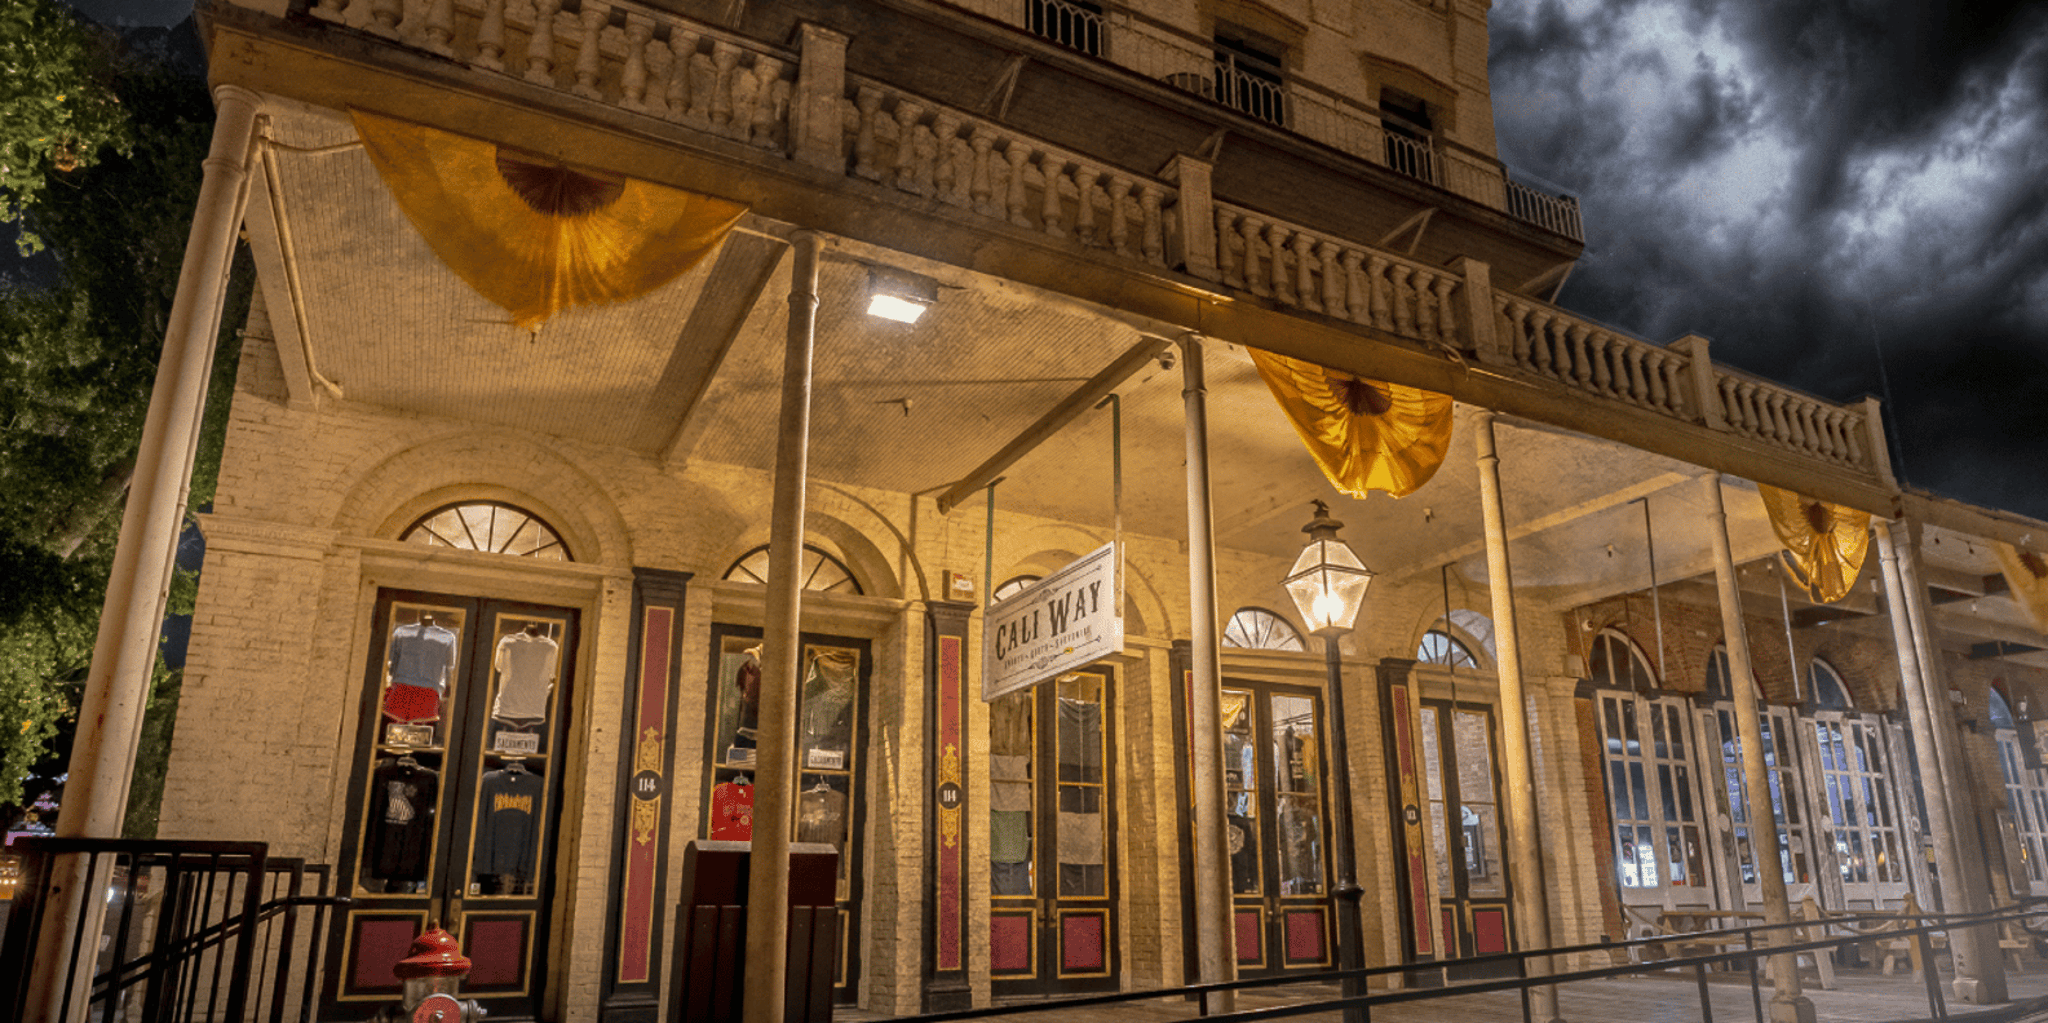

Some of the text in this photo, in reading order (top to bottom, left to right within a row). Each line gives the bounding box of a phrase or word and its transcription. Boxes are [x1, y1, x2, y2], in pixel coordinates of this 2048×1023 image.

[996, 580, 1102, 660] CALI WAY
[639, 778, 656, 791] 114
